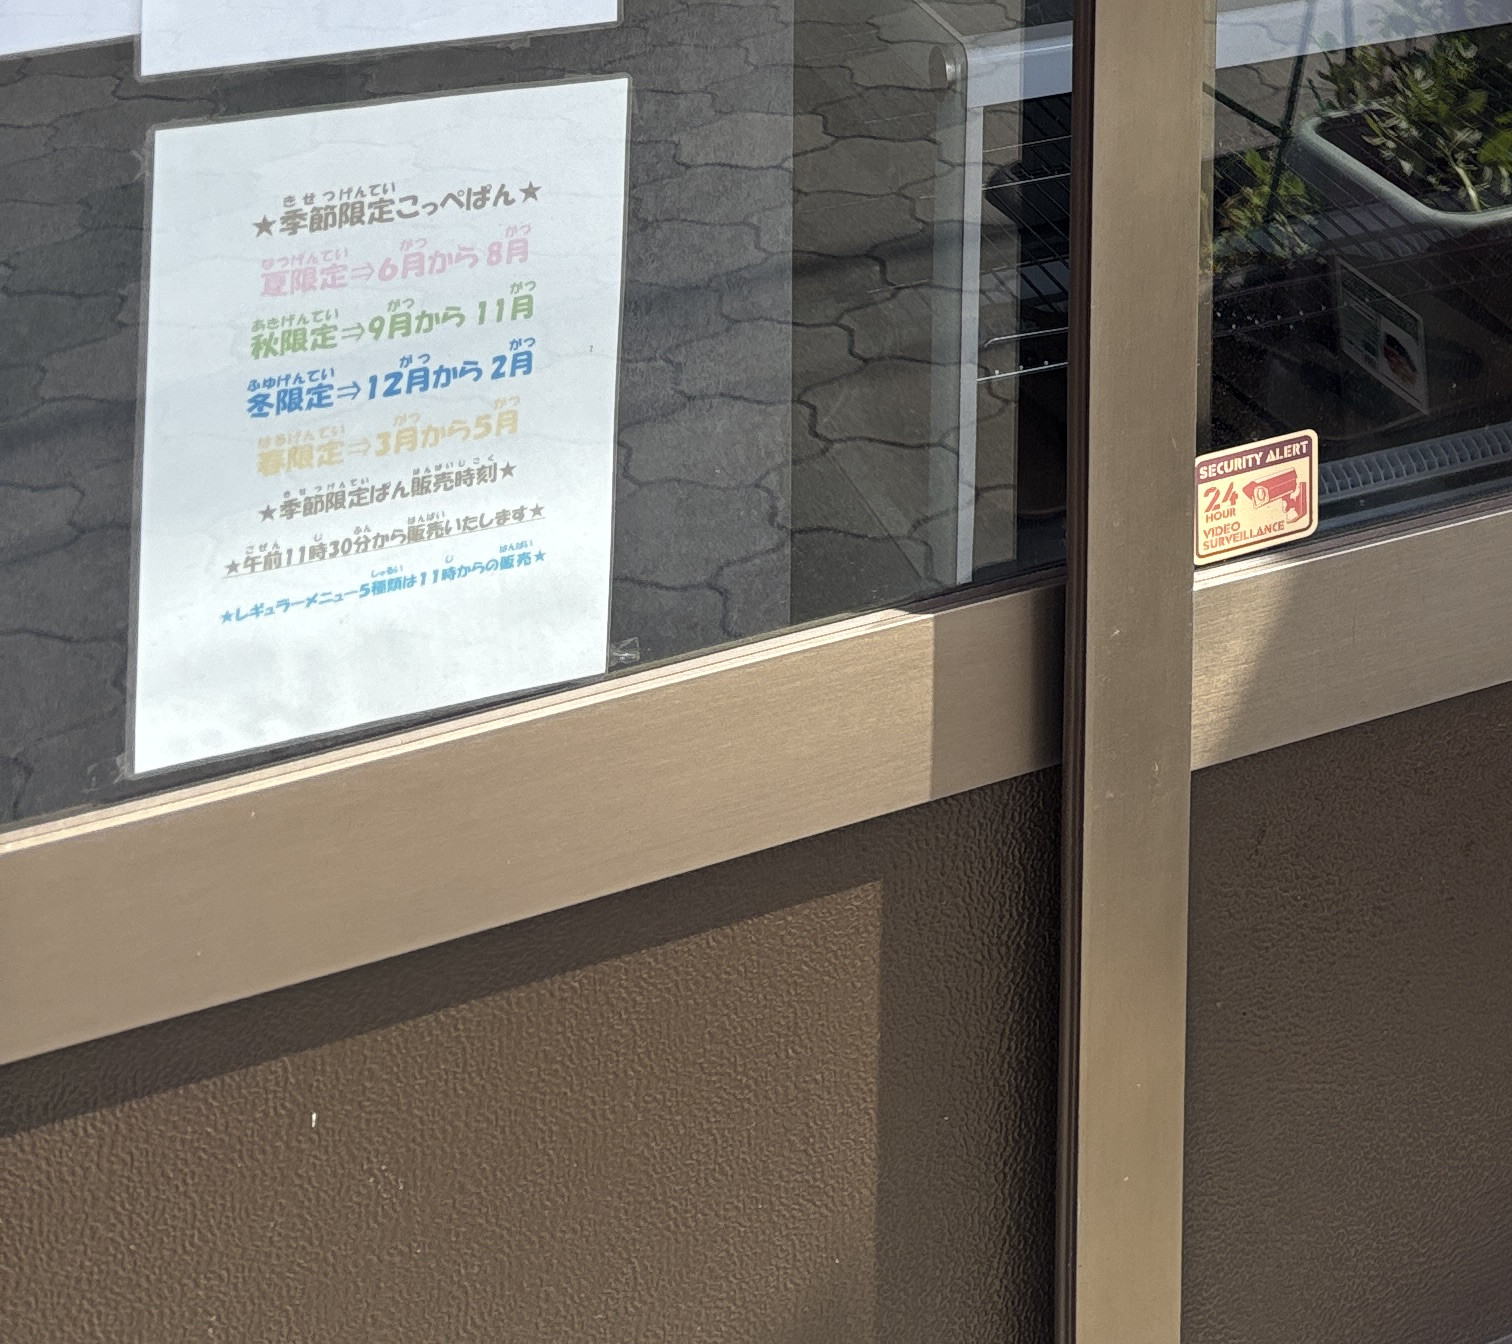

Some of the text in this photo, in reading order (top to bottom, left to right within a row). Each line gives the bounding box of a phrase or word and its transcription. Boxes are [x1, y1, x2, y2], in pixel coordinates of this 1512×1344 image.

[1199, 440, 1309, 480] SECURITY ALERT
[1203, 482, 1239, 514] 24
[1203, 521, 1241, 539] VIDEO
[1206, 508, 1236, 523] HOUR
[1203, 520, 1285, 551] SURVEILLANCE
